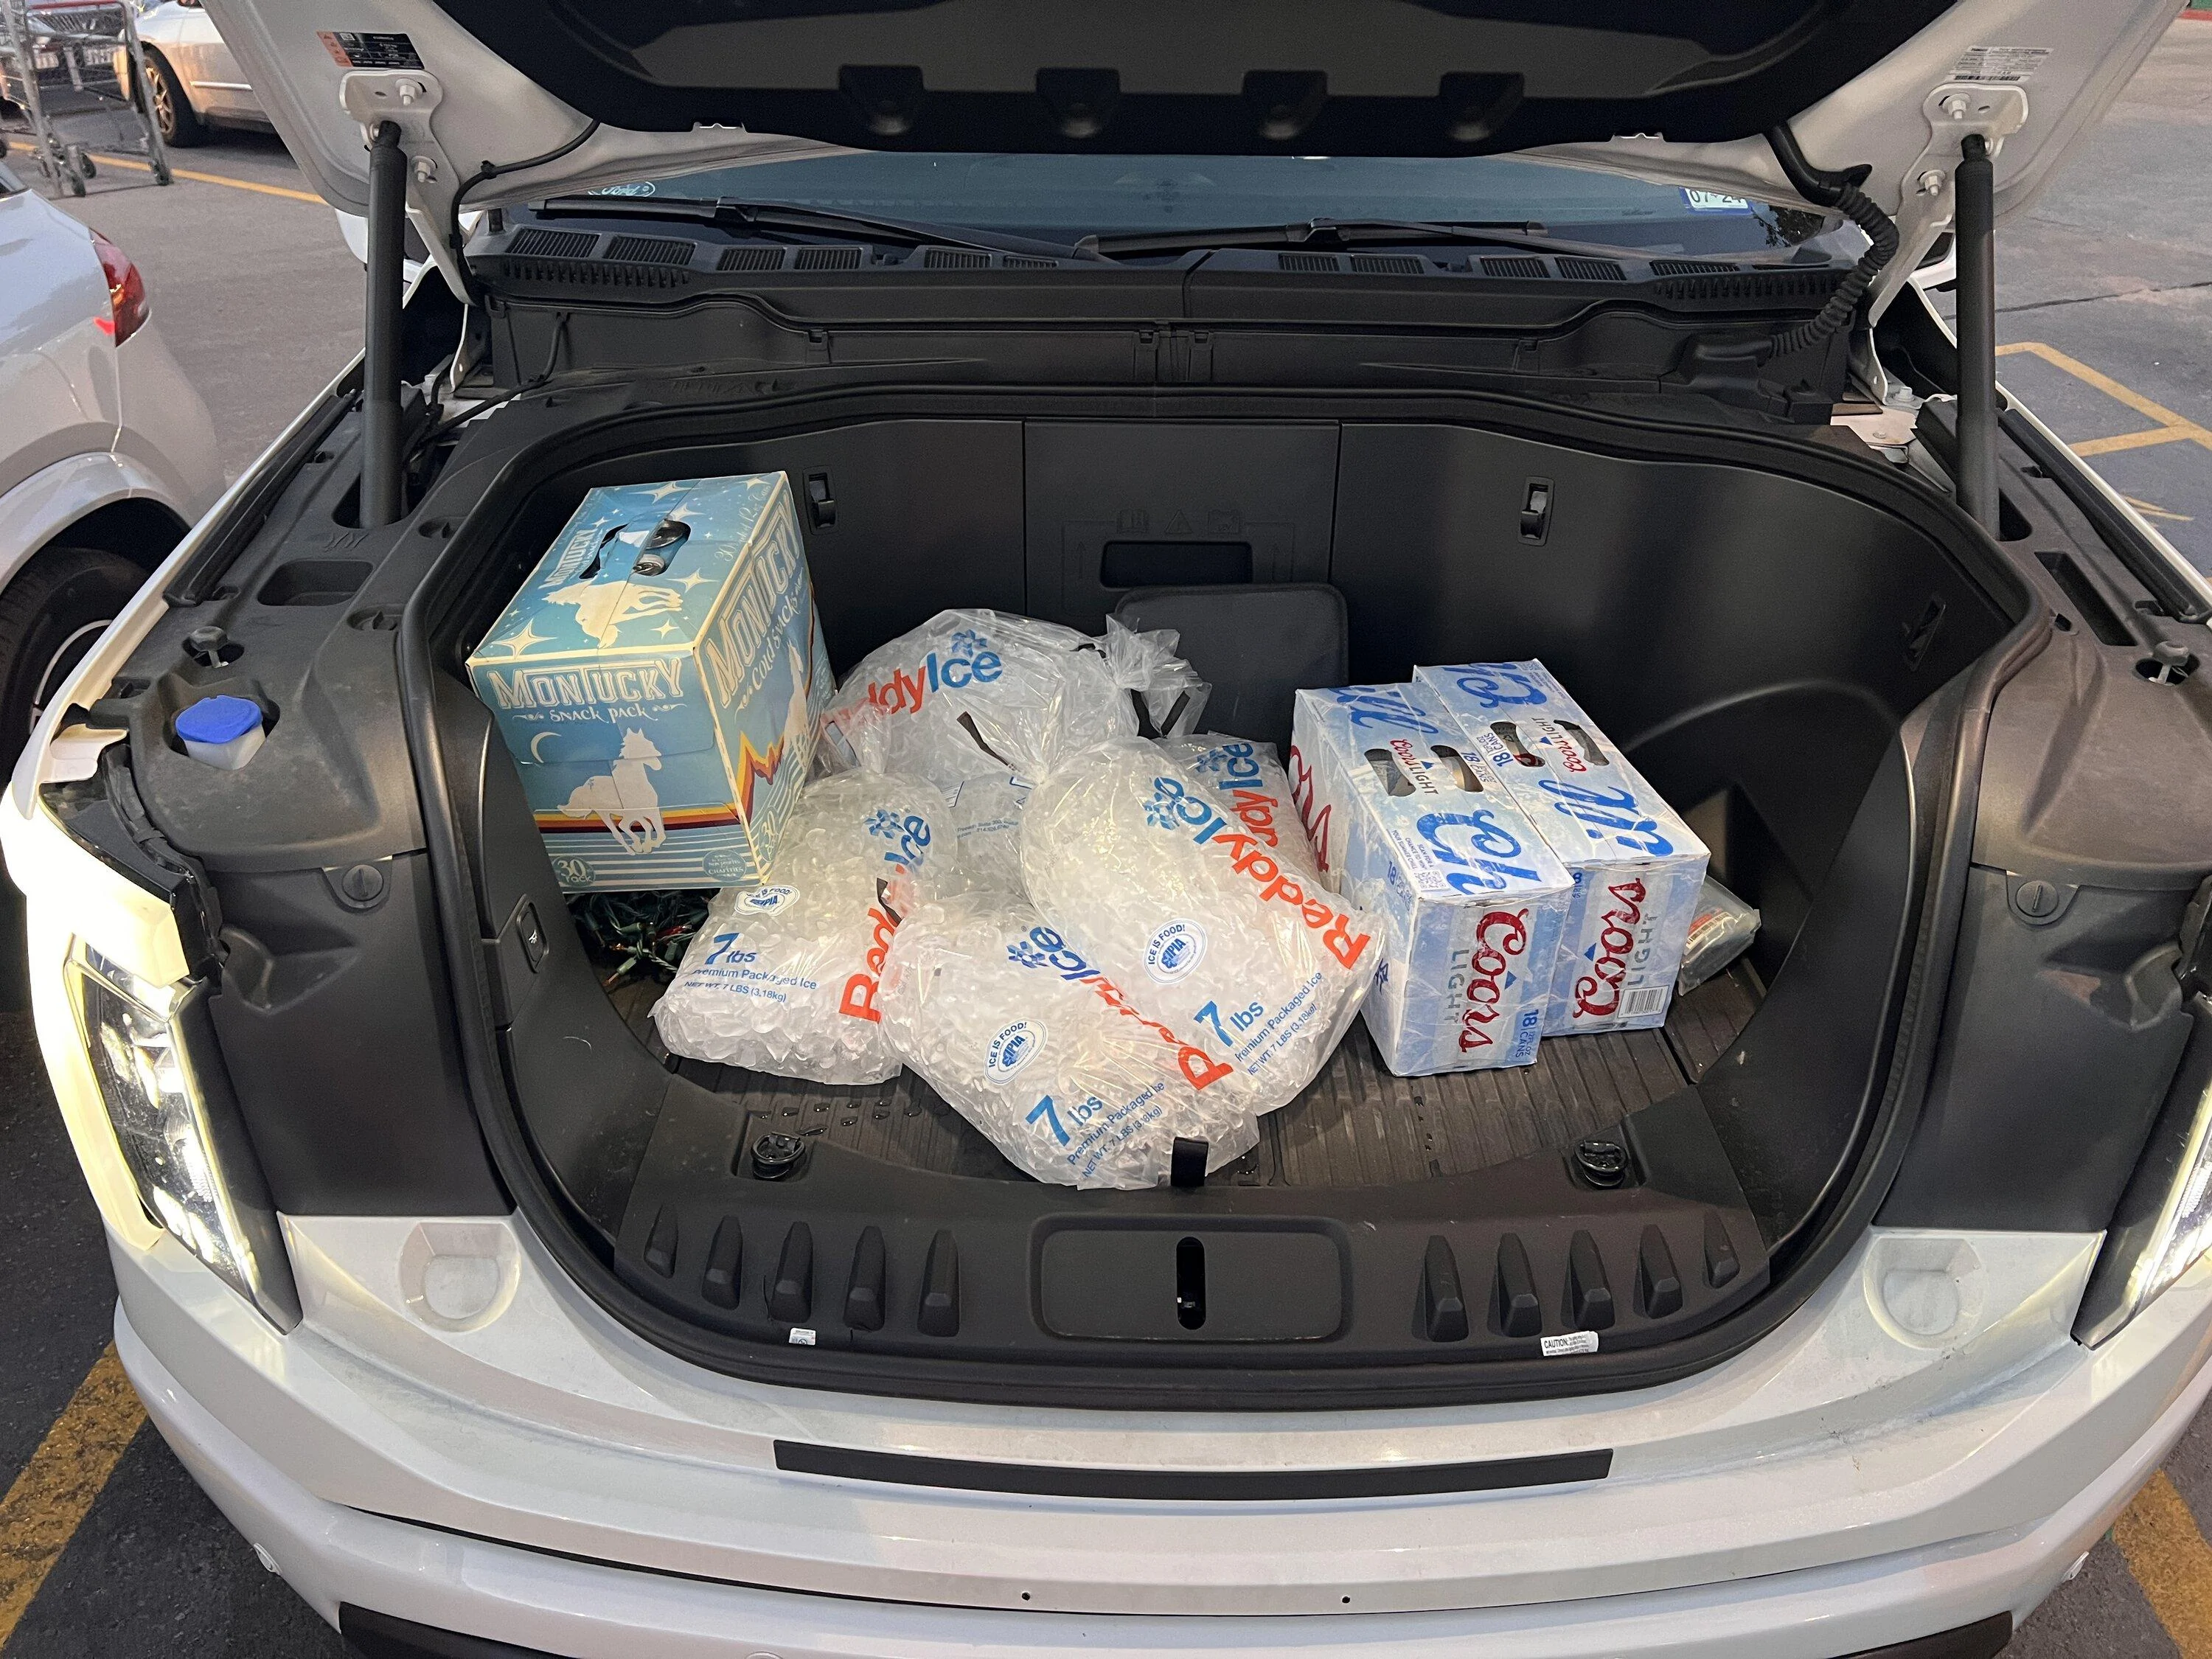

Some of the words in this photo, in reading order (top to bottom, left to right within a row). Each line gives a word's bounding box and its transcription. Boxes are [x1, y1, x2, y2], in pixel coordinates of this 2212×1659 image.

[706, 490, 799, 709] MONTUCKY
[487, 658, 684, 709] MONTUCKY
[1484, 732, 1503, 751] CANS
[1532, 717, 1563, 740] LIGHT
[1390, 739, 1416, 768] Coors
[1461, 752, 1481, 762] 18
[1492, 752, 1514, 767] 18
[1554, 740, 1587, 772] Coors
[1410, 765, 1439, 795] LIGHT
[557, 860, 587, 877] 30
[1152, 939, 1161, 948] IS
[1158, 925, 1186, 941] FOOD!
[705, 933, 740, 964] 7
[726, 950, 757, 964] lbs
[1148, 949, 1157, 964] ICE
[1573, 877, 1646, 1018] Coors
[1627, 914, 1658, 985] LIGHT
[800, 978, 817, 990] Ice
[1444, 949, 1470, 1023] LIGHT
[1458, 908, 1529, 1053] Coors
[730, 985, 749, 994] LBS
[751, 988, 787, 1003] (3.18kg)
[1267, 985, 1312, 1030] Packaged
[1307, 972, 1323, 989] Ice
[999, 1022, 1027, 1040] FOOD!
[1193, 1001, 1234, 1047] 7
[1229, 1001, 1264, 1032] lbs
[1523, 1009, 1539, 1027] 18
[992, 1040, 1001, 1049] IS
[1276, 1031, 1293, 1047] LBS
[1516, 1032, 1528, 1058] CANS
[989, 1051, 998, 1068] ICE
[1025, 1095, 1070, 1147] 7
[1067, 1096, 1103, 1127] lbs
[1067, 1123, 1110, 1165] Premium
[1107, 1087, 1153, 1124] Packaged
[1082, 1160, 1096, 1178] NET
[1116, 1125, 1134, 1141] LBS
